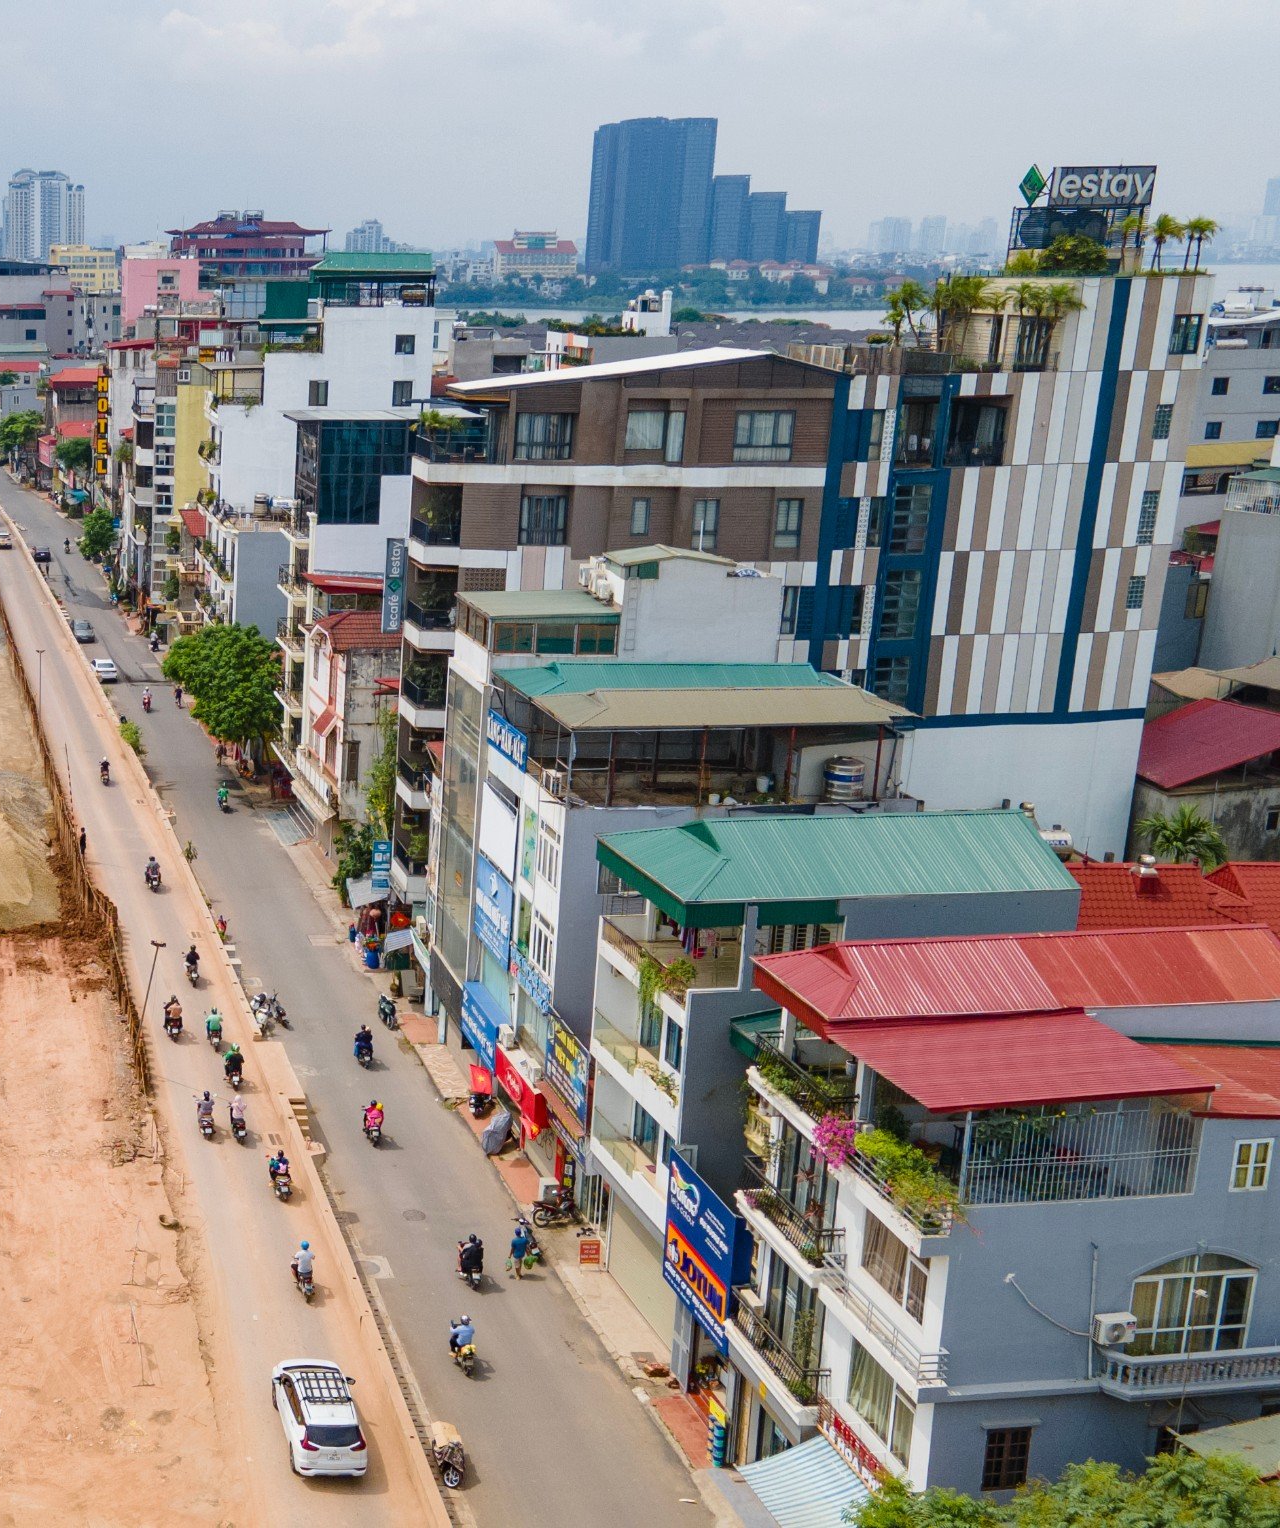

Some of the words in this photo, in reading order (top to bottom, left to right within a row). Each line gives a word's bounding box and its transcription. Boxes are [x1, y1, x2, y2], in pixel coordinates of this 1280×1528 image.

[1051, 167, 1154, 204] lestay
[97, 376, 108, 474] HOTEL
[389, 541, 403, 578] lestay
[387, 594, 399, 630] lecafé
